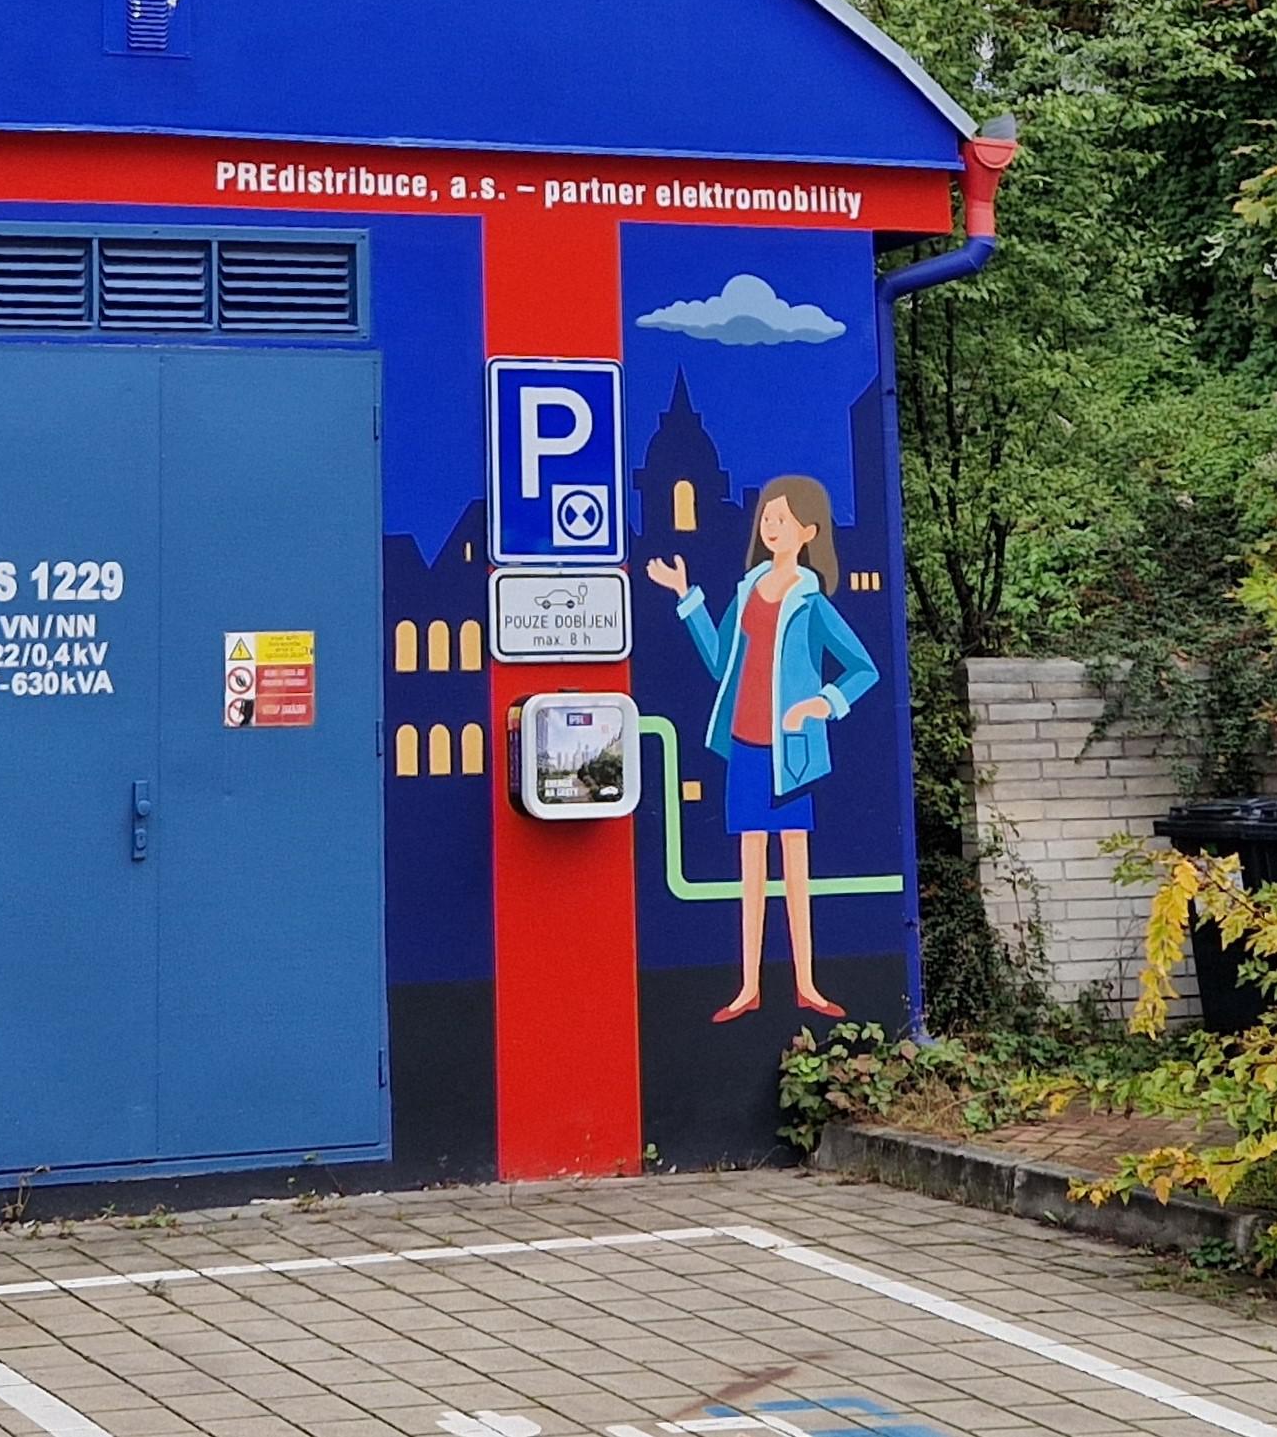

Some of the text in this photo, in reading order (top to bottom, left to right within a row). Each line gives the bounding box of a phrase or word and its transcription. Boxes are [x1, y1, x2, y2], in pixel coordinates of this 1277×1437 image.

[215, 161, 439, 202] PREdistribuce,
[450, 175, 506, 200] a.s.
[544, 177, 646, 209] partner
[655, 180, 863, 220] elektromobility
[519, 386, 593, 499] P
[30, 561, 124, 601] 1229
[504, 610, 617, 629] POUZE DOBÍJENÍ
[583, 631, 591, 646] h
